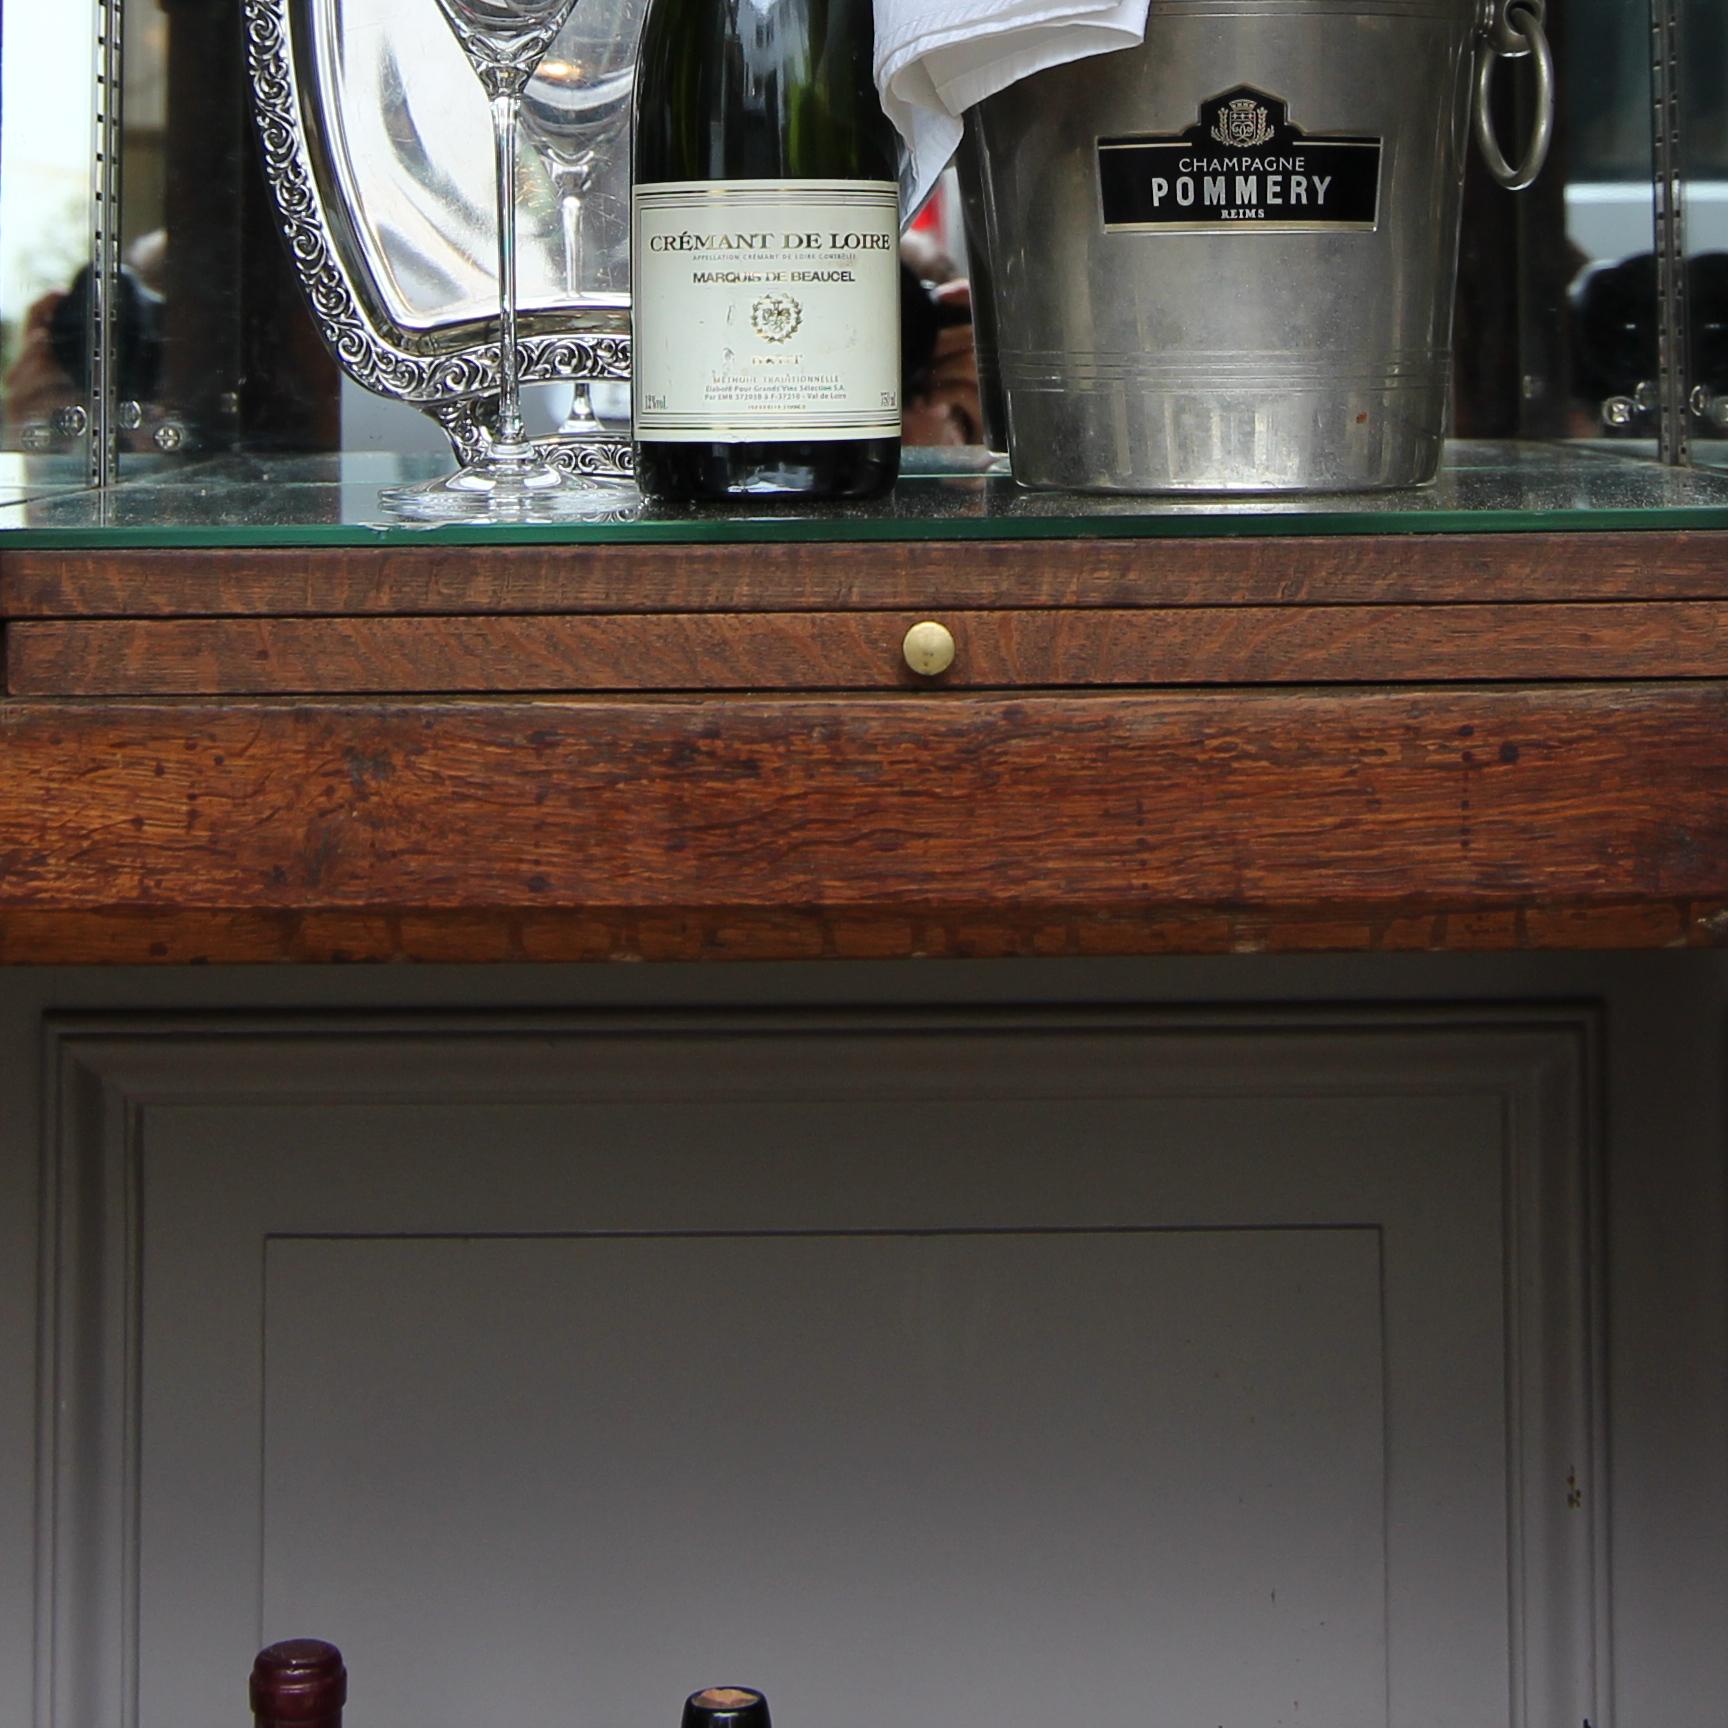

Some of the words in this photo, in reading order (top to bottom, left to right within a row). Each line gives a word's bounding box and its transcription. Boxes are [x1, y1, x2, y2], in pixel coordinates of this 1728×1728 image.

[1179, 157, 1305, 172] CHAMPAGNE
[1151, 175, 1332, 207] POMMERY
[1220, 209, 1265, 220] REIMS
[650, 231, 775, 252] CRÉMANT
[783, 233, 822, 250] DE
[830, 233, 891, 250] LOIRE
[693, 272, 761, 284] MARQUIS
[765, 272, 789, 282] DE
[791, 271, 855, 282] BEAUCEL
